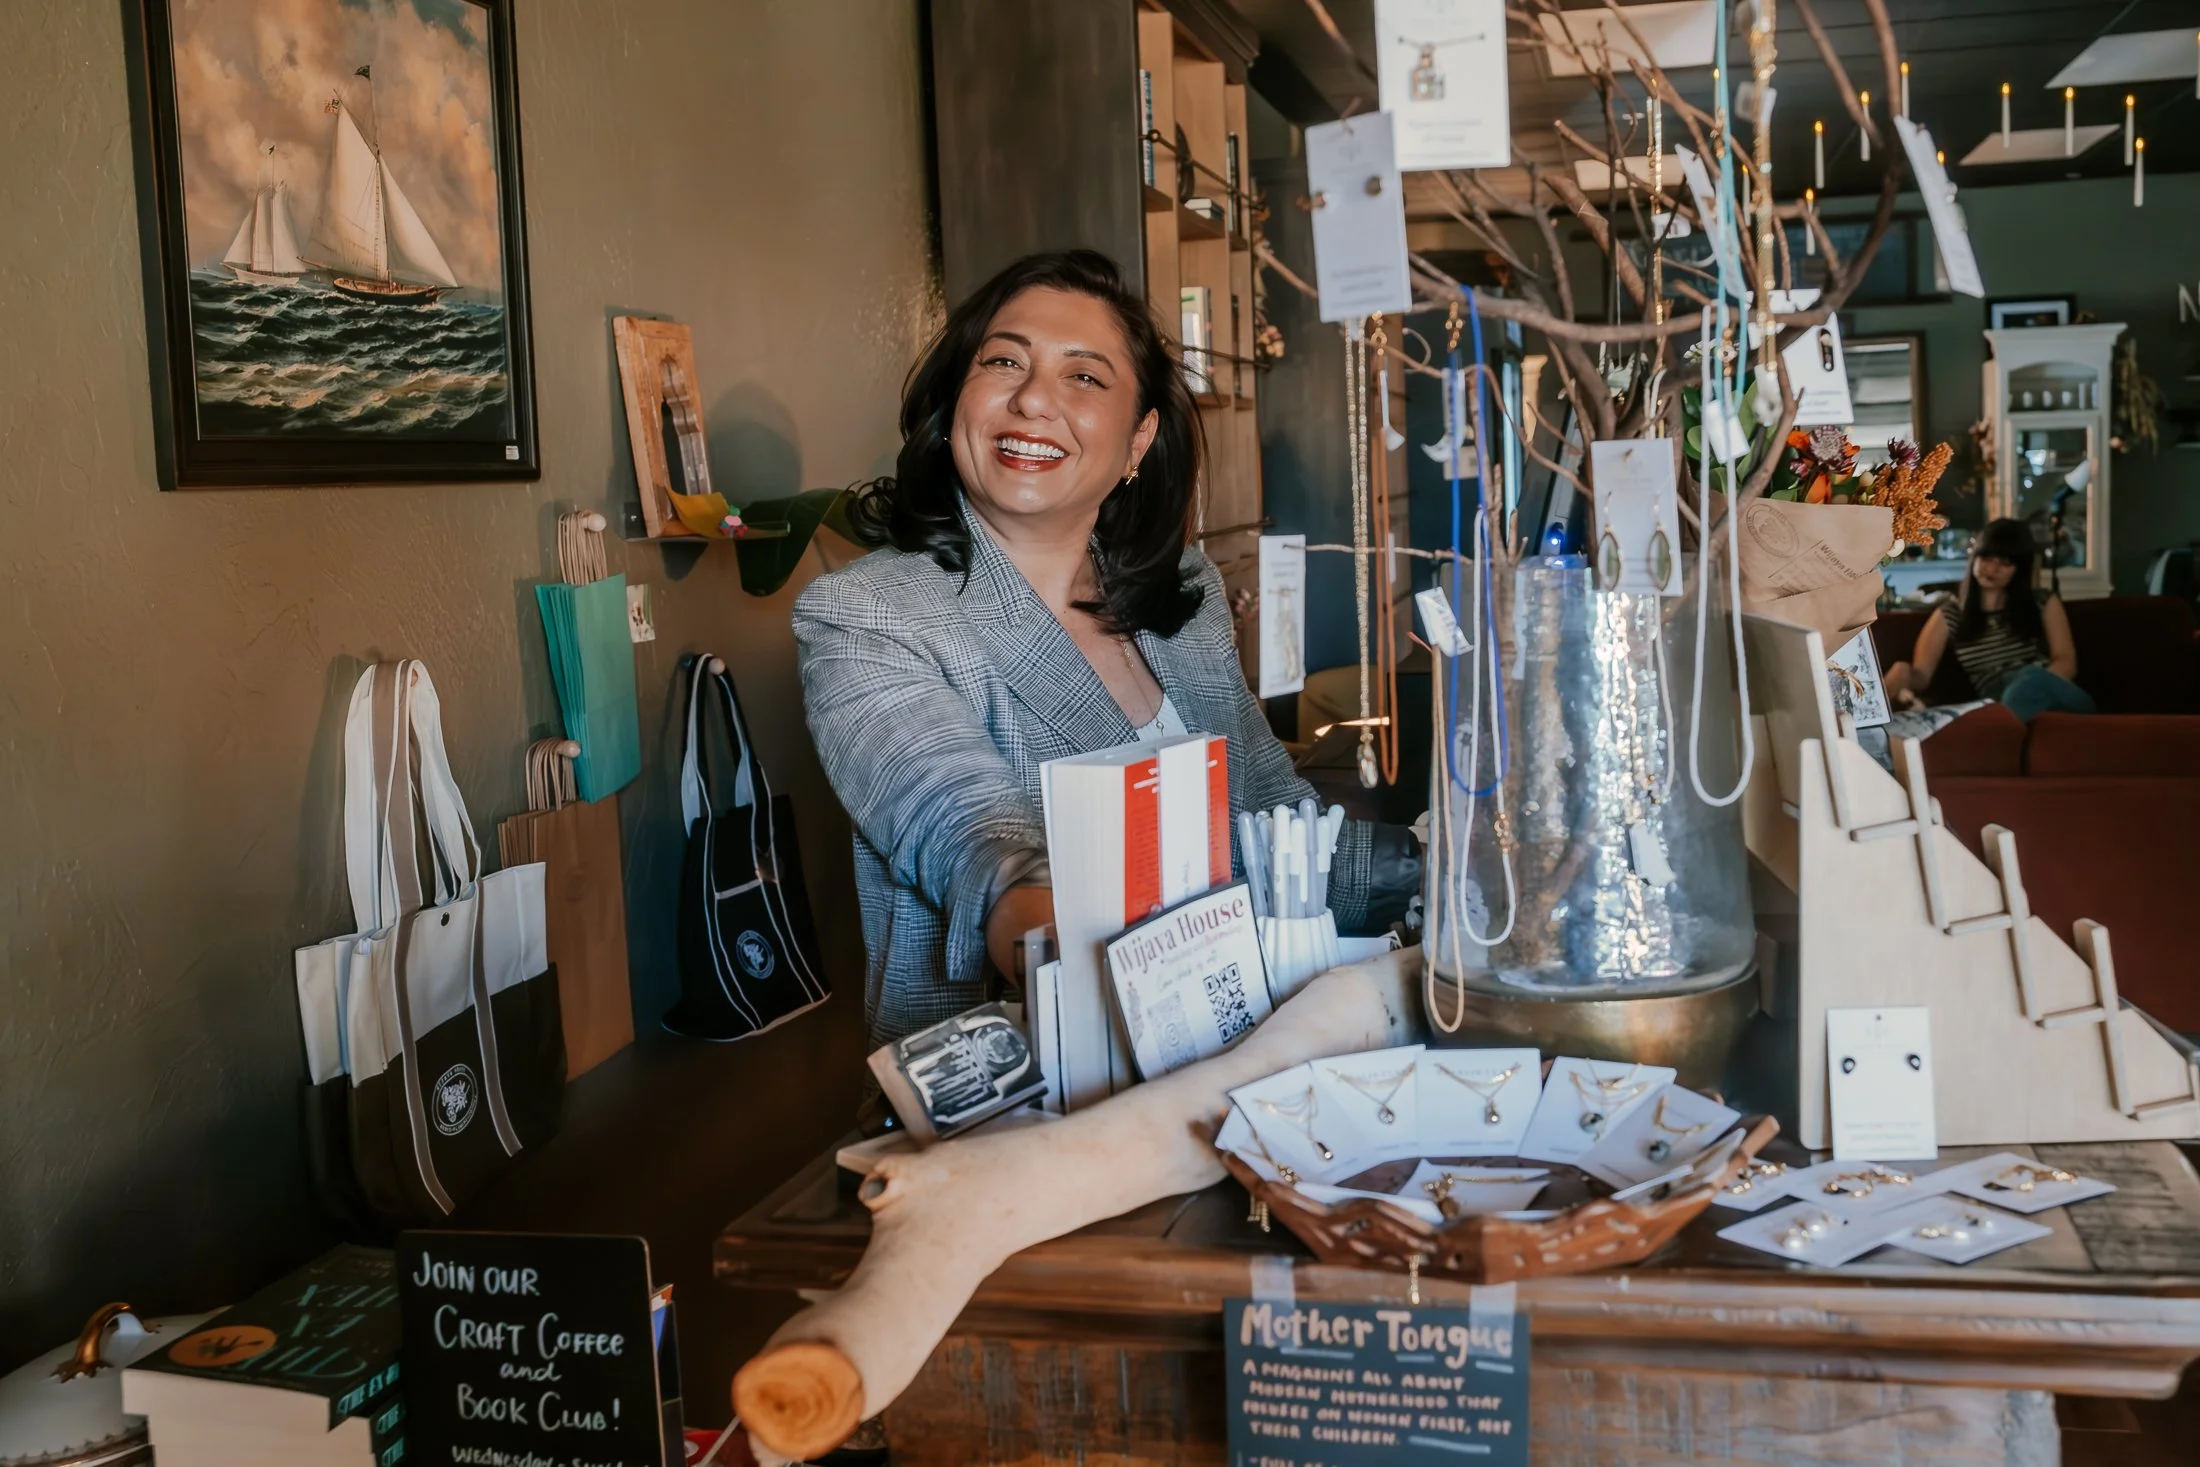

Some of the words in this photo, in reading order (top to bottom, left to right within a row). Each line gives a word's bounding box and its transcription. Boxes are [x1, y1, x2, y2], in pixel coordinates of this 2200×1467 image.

[1116, 935, 1176, 974] Wijaya
[1176, 897, 1245, 943] House
[1241, 1303, 1374, 1348] Mother
[1375, 1310, 1513, 1370] Tongue
[499, 1362, 562, 1381] and
[1243, 1359, 1257, 1375] A
[1402, 1374, 1466, 1391] ABOUT
[1249, 1380, 1321, 1401] MODERN
[1331, 1390, 1449, 1409] MOTHERHOOD
[1457, 1396, 1503, 1411] THAT
[1250, 1421, 1301, 1440] THEIR
[1347, 1411, 1412, 1429] WOMEN
[1478, 1418, 1512, 1435] NOT
